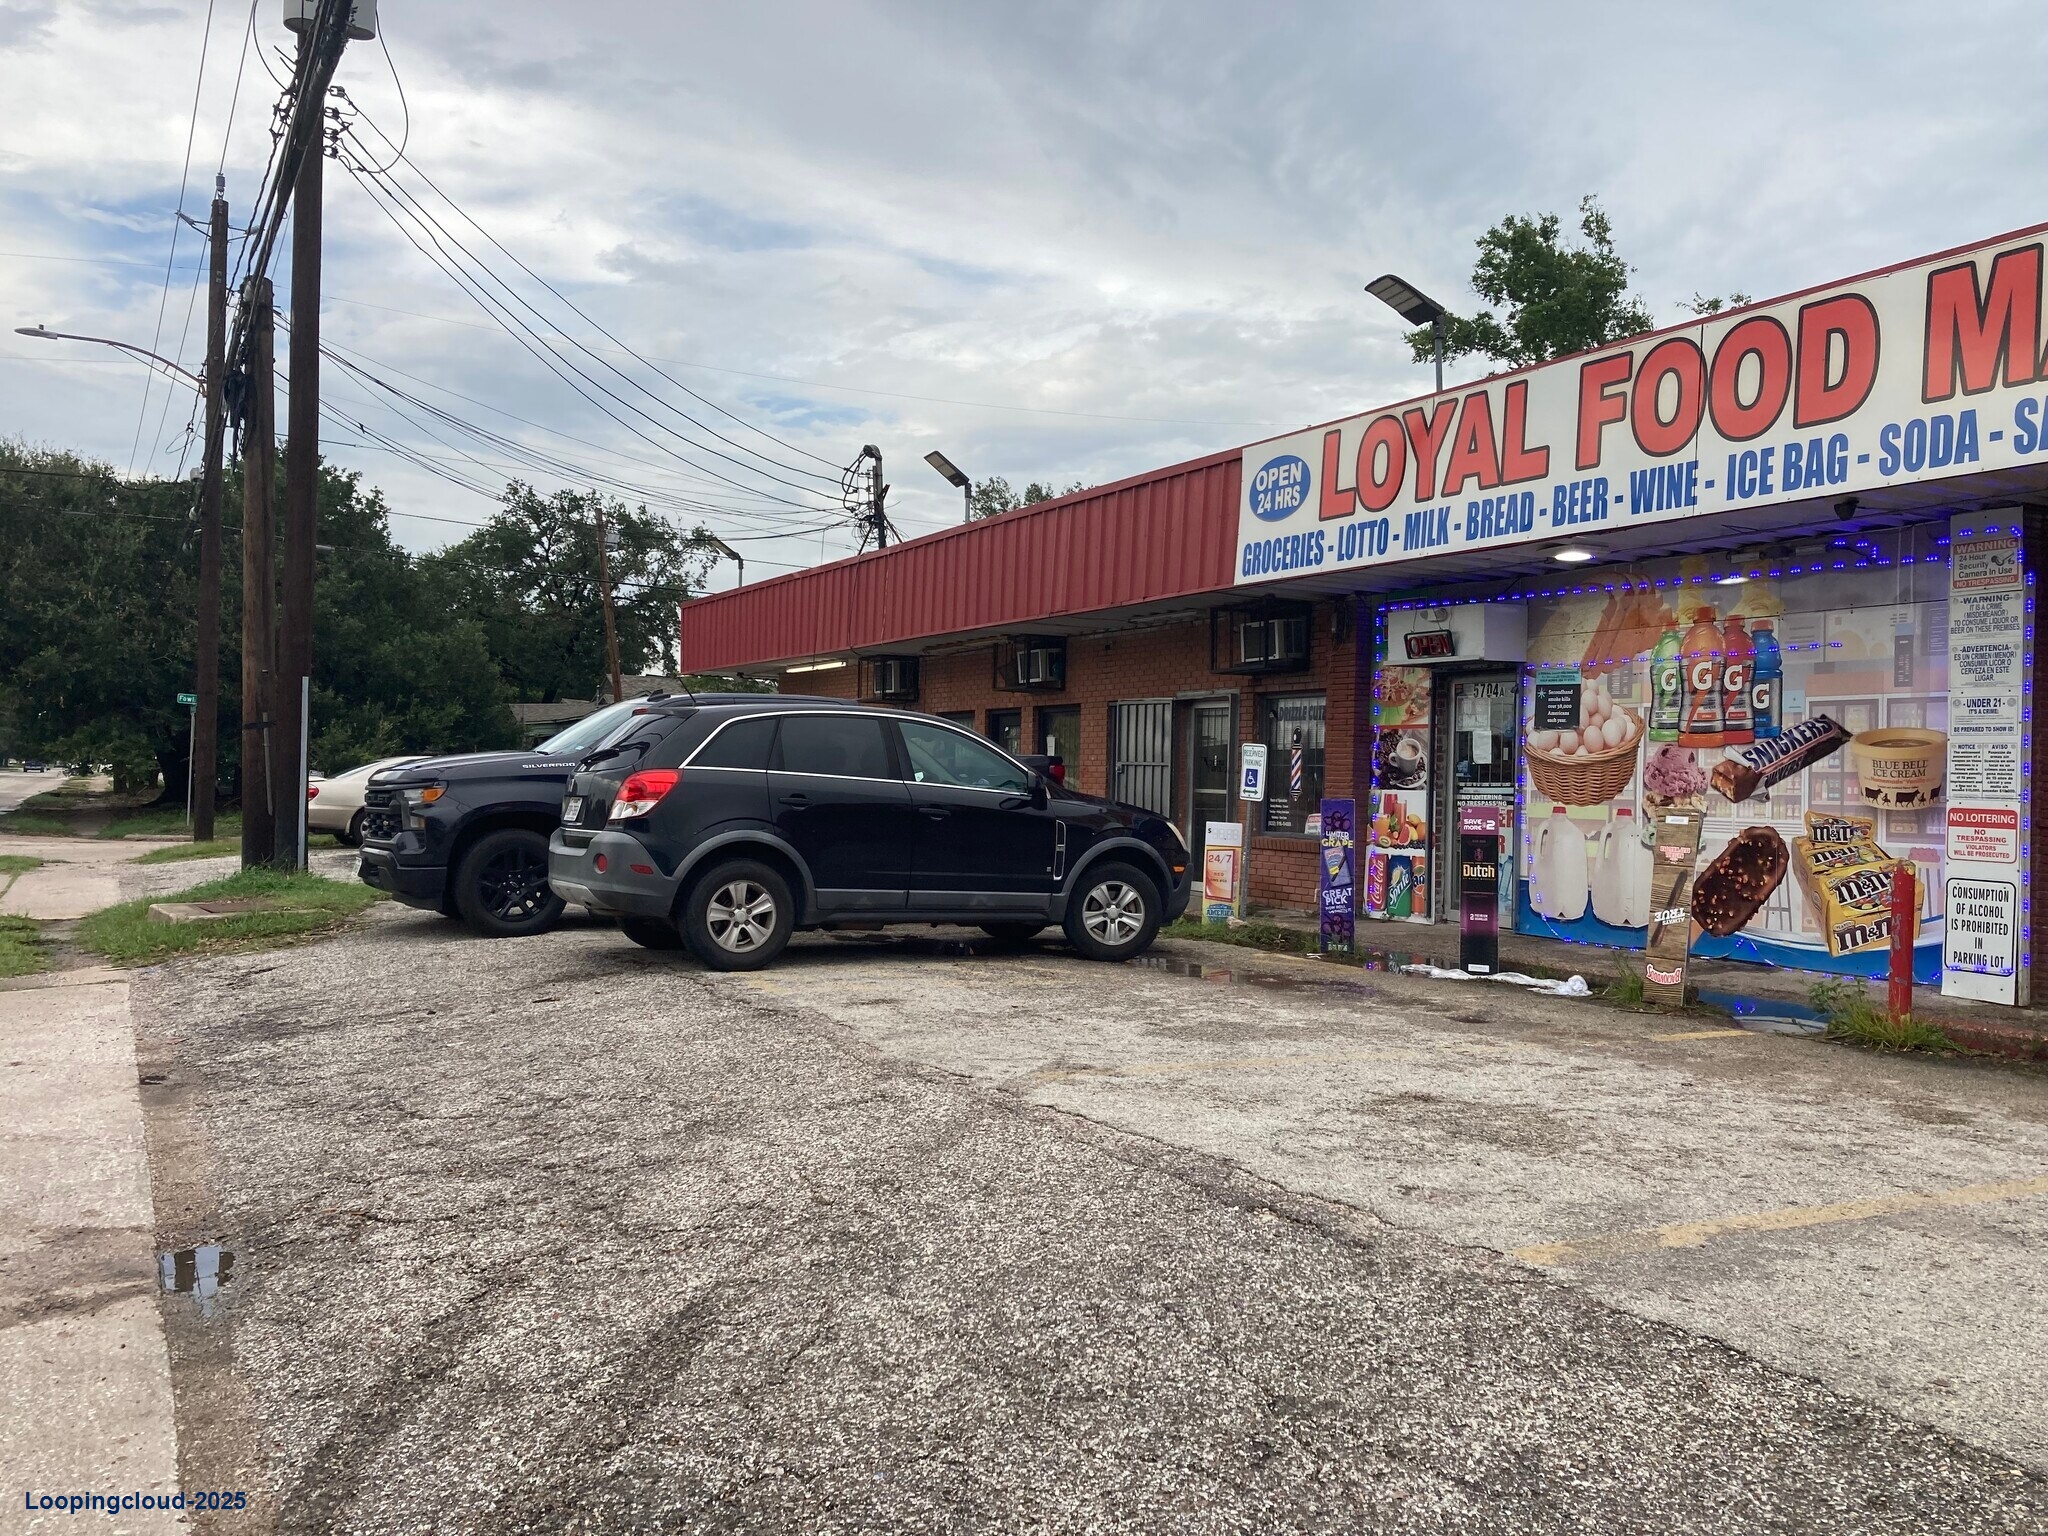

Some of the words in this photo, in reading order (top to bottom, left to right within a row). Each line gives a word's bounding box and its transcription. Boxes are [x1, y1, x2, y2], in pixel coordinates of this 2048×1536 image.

[1319, 378, 1550, 522] LOYAL
[1575, 292, 1881, 471] FOOD
[1921, 242, 2048, 404] M
[1256, 460, 1303, 493] OPEN
[1242, 530, 1325, 577] GROCERIES
[1337, 517, 1390, 561] LOTTO
[1403, 504, 1452, 551] MILK
[1465, 490, 1535, 541] BREAD
[1552, 477, 1608, 527] BEER
[1629, 460, 1699, 514] WINE
[1726, 446, 1775, 500] ICE
[1782, 432, 1848, 491] BAG
[1878, 409, 1980, 476] SODA
[1256, 492, 1274, 514] 24
[1274, 485, 1301, 510] HRS
[1955, 538, 2016, 554] WARNING
[1959, 555, 1967, 563] 24
[1970, 553, 1986, 561] Hour
[1959, 562, 1989, 571] Security
[1958, 570, 1987, 579] Camera
[1998, 567, 2013, 575] Use
[1956, 580, 1967, 588] NO
[1968, 575, 2016, 587] TRESPASSING
[1986, 602, 2003, 610] CRIME
[1962, 617, 1987, 626] CONSUME
[1989, 616, 2009, 625] LIQUOR
[2010, 615, 2019, 623] OR
[1950, 626, 1964, 634] BEER
[1975, 625, 1993, 633] THESE
[1408, 634, 1452, 658] OPEN
[1954, 653, 1961, 661] ES
[1971, 652, 1992, 660] CRIMEN
[1993, 651, 2017, 659] (MENOR)
[1960, 660, 1988, 668] CONSUMIR
[1989, 659, 2006, 667] LICOR
[2007, 658, 2012, 666] O
[1692, 660, 1713, 691] G
[1960, 667, 1985, 675] CERVEZA
[1660, 668, 1677, 691] G
[1723, 664, 1743, 691] G
[1752, 683, 1770, 710] G
[1279, 705, 1308, 721] DRIZZLE
[1741, 717, 1832, 772] SNICKERS
[1244, 749, 1264, 758] RESERVED
[1245, 758, 1262, 767] PARKING
[1871, 760, 1900, 770] BLUE
[1902, 760, 1929, 770] BELL
[1872, 768, 1888, 778] ICE
[1889, 768, 1926, 778] CREAM
[1950, 812, 1964, 822] NO
[1965, 813, 2015, 824] LOITERING
[1486, 819, 1496, 831] 2
[1325, 830, 1350, 838] LIMITED
[1956, 835, 2007, 844] TRESPASSING
[1321, 838, 1354, 849] GRAPE
[1966, 844, 1996, 852] VIOLATORS
[1208, 854, 1232, 864] 24/7
[1972, 851, 2010, 859] PROSECUTED
[1462, 864, 1495, 878] Dutch
[1322, 888, 1353, 899] GREAT
[1388, 872, 1411, 906] Sprite
[1952, 886, 2009, 902] CONSUMPTION
[1325, 895, 1348, 906] PICK
[1469, 913, 1475, 921] 2
[1654, 907, 1687, 922] TRUE
[1956, 903, 1965, 915] OF
[1968, 904, 2004, 919] ALCOHOL
[1951, 918, 1959, 930] IS
[1961, 919, 2008, 936] PROHIBITED
[1974, 937, 1983, 949] IN
[1953, 951, 1988, 967] PARKING
[1990, 955, 2004, 969] LOT
[1646, 963, 1683, 985] BACKWOODS
